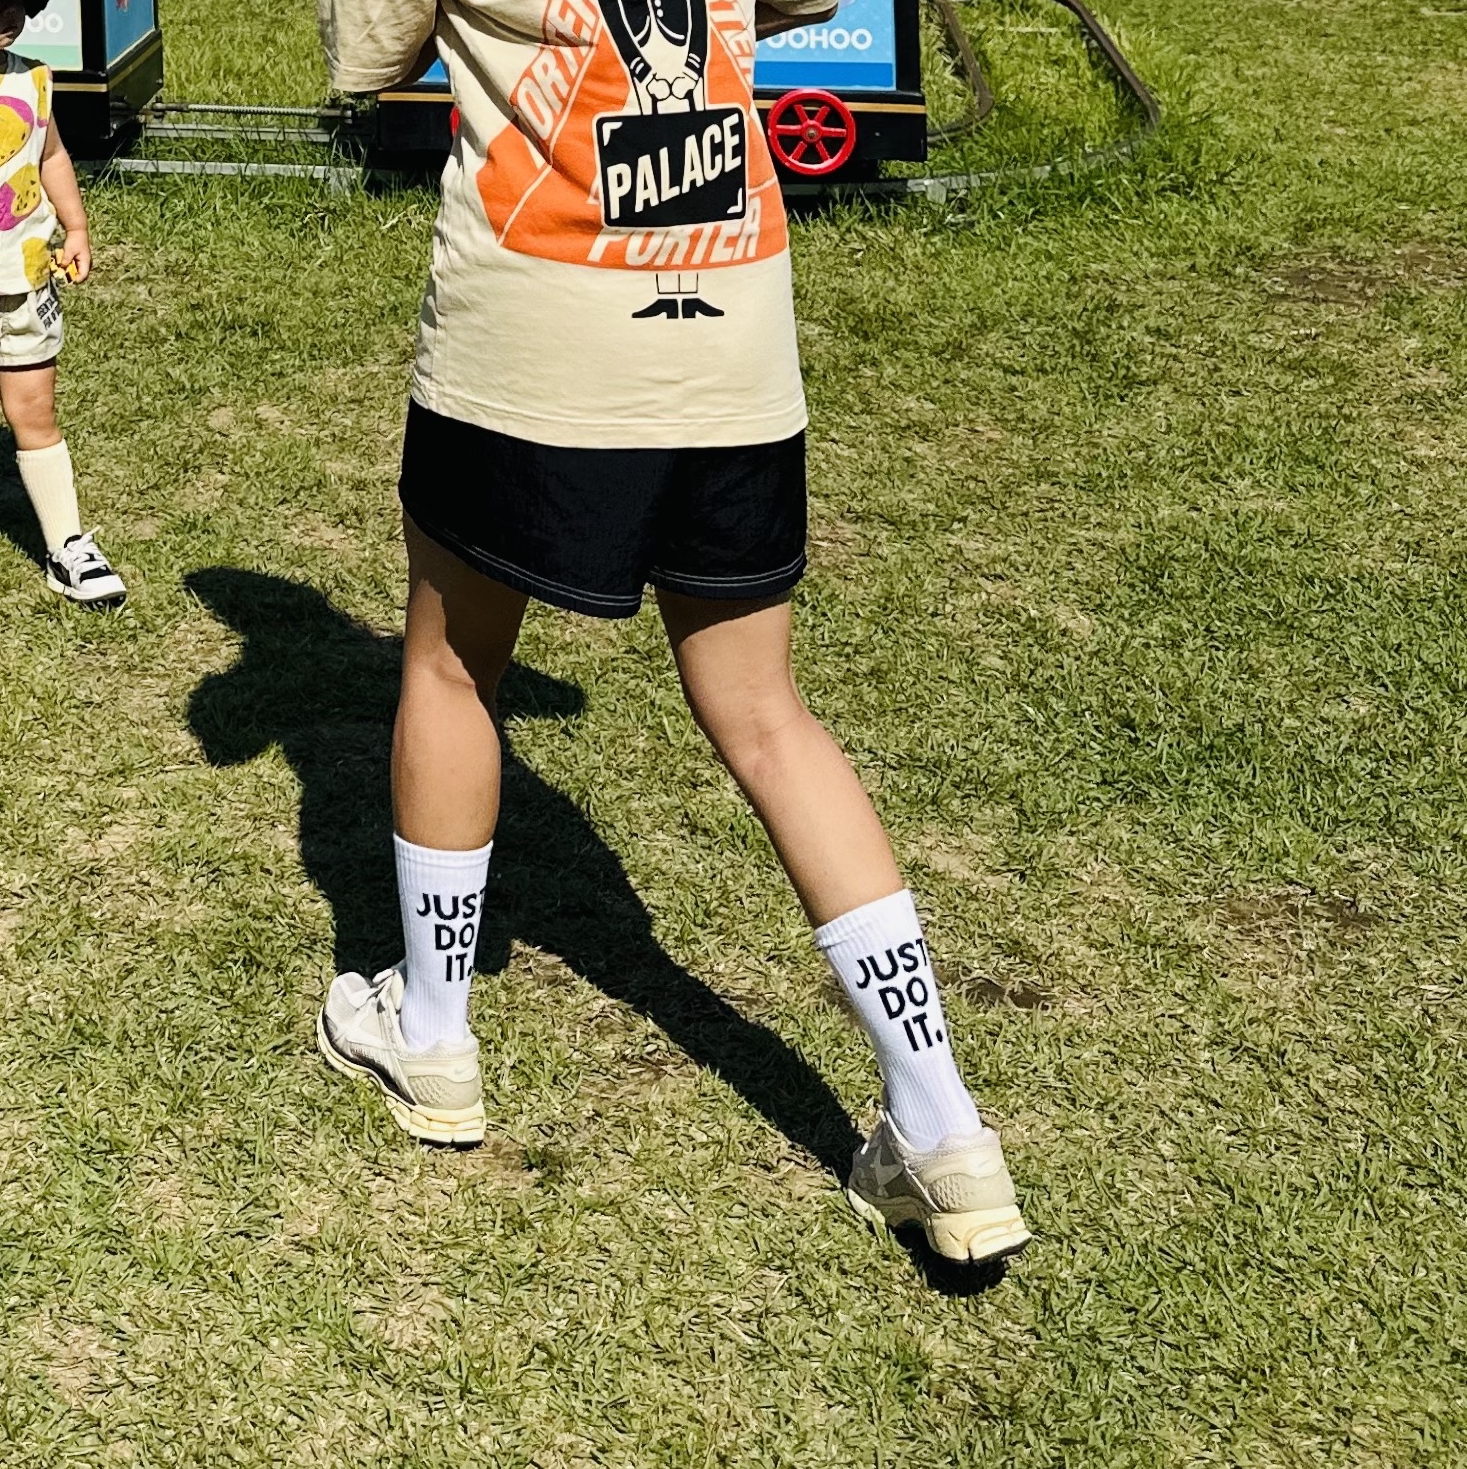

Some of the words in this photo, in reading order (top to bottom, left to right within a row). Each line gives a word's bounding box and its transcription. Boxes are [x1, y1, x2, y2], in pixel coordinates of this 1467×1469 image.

[756, 27, 873, 50] OOHOO
[606, 112, 742, 220] PALACE
[434, 922, 475, 950] DO
[877, 976, 929, 1020] DO
[902, 1012, 943, 1052] IT.
